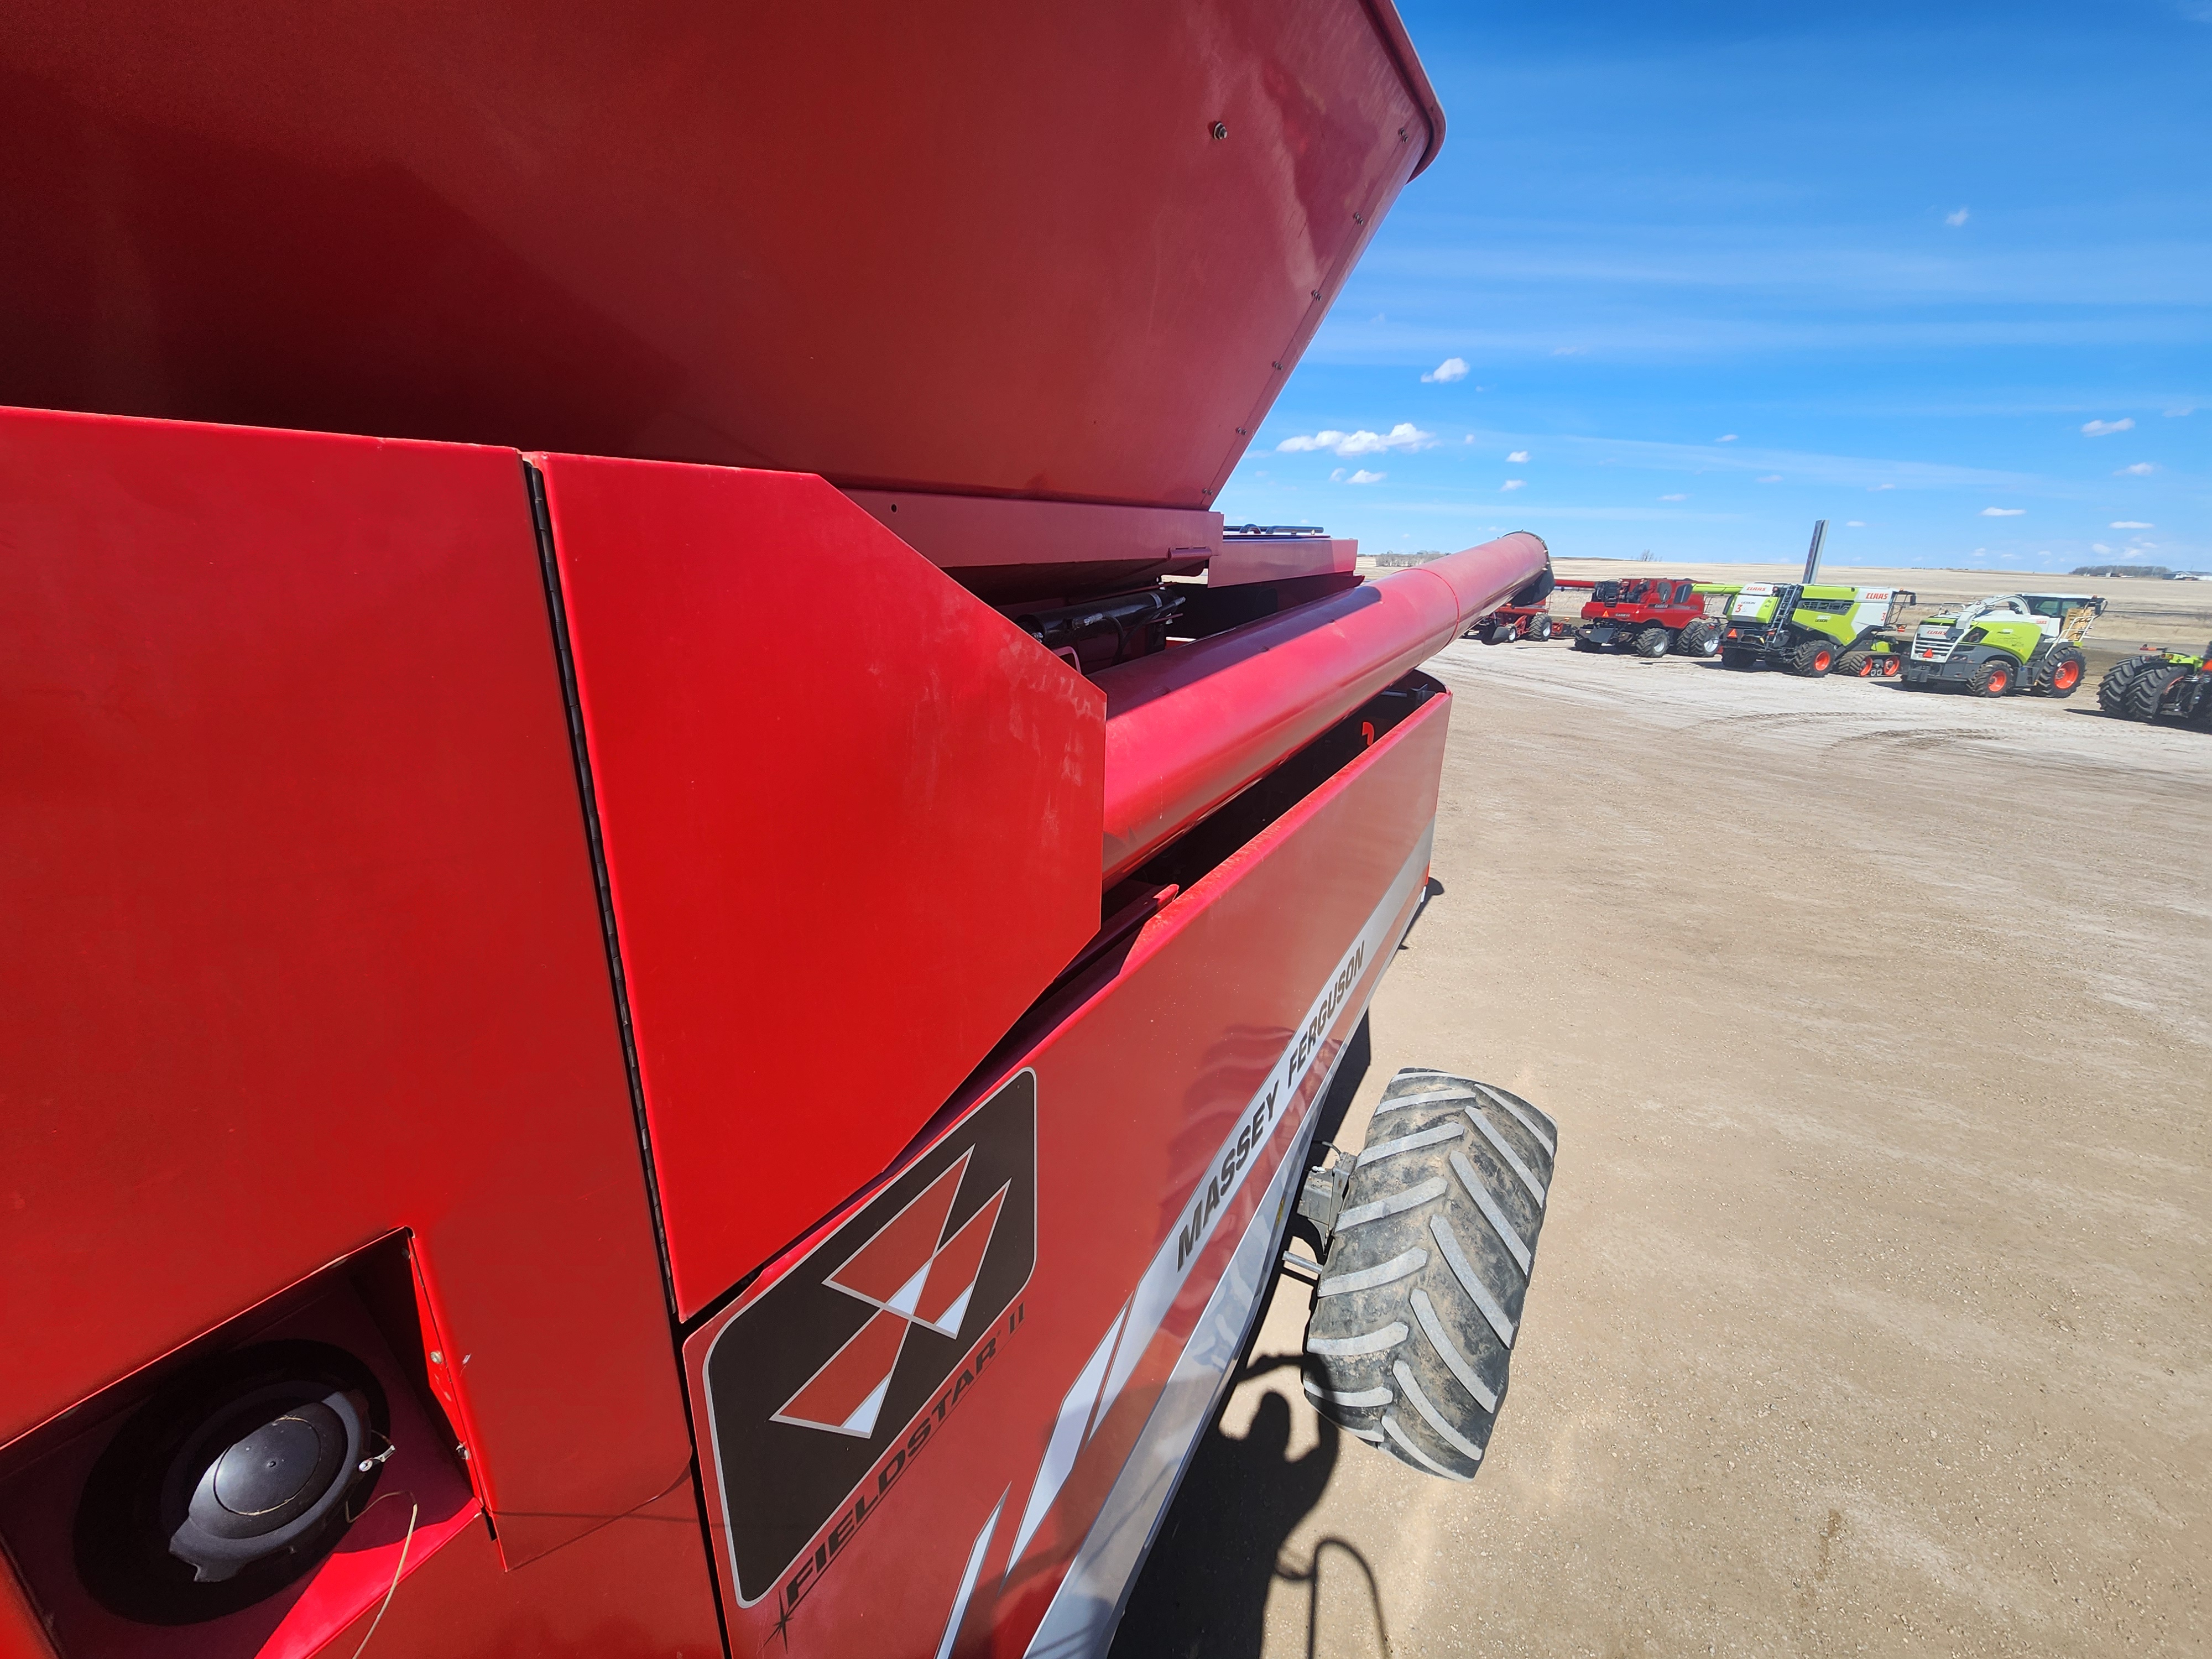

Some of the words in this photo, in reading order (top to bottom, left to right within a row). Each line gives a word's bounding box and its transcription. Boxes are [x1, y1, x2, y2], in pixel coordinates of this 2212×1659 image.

[1735, 604, 1743, 613] 3
[1881, 613, 1886, 621] 3
[1177, 1080, 1279, 1272] MASSEY
[1287, 940, 1365, 1089] FERGUSON
[786, 1336, 997, 1608] FIELDSTAR
[1009, 1302, 1025, 1335] II
